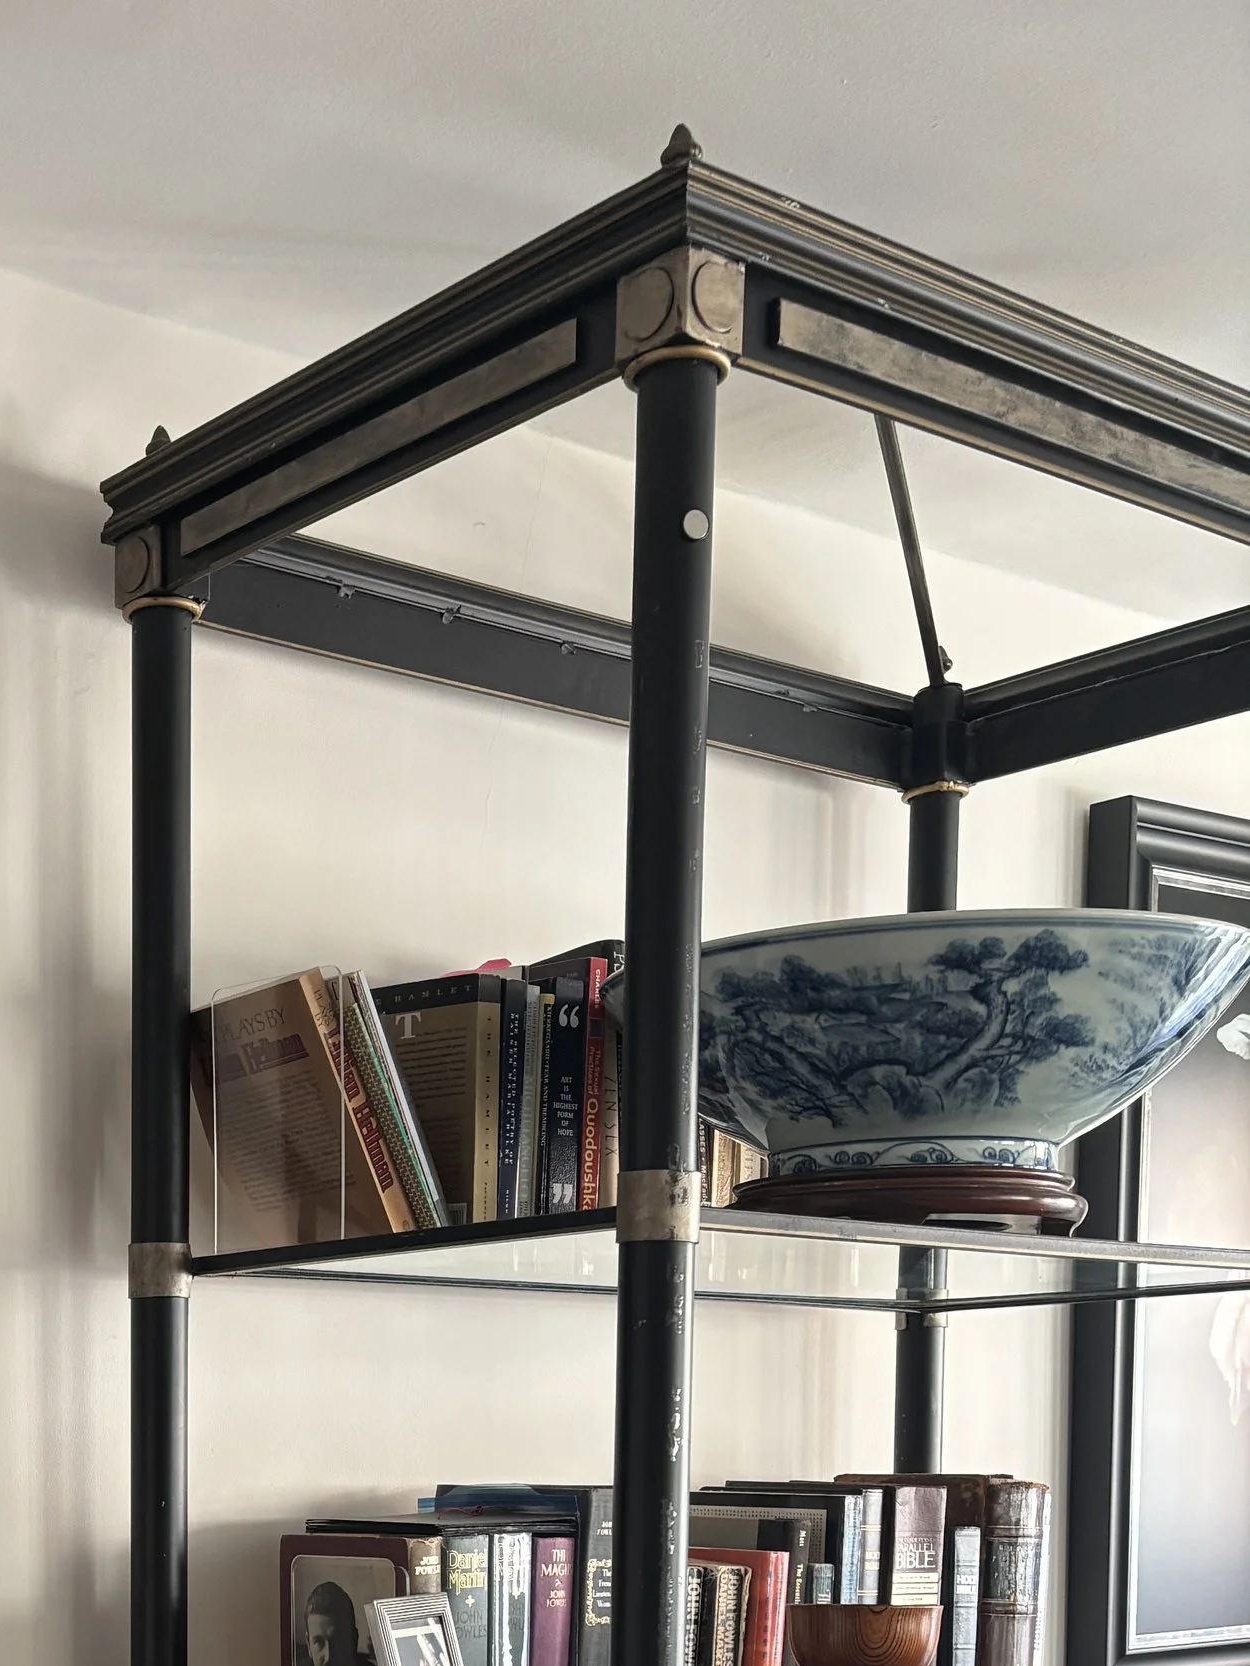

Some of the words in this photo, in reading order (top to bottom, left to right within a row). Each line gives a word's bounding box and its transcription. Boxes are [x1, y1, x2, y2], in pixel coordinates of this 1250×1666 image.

[394, 985, 472, 1003] HAMLET
[265, 1006, 285, 1028] BY
[560, 1076, 573, 1084] ART
[553, 1101, 578, 1110] HIGHEST
[560, 1093, 573, 1101] THE
[557, 1110, 574, 1119] FORM
[561, 1119, 569, 1127] OF
[557, 1128, 574, 1137] HOPE
[604, 1120, 618, 1158] SEX
[352, 1101, 394, 1194] Hellman
[446, 1549, 488, 1571] Daniel
[895, 1552, 936, 1569] BIBLE
[687, 1576, 701, 1621] JOHN
[717, 1574, 728, 1624] DANIEL
[726, 1574, 740, 1614] JOHN
[454, 1609, 484, 1625] JOHN
[456, 1624, 488, 1639] OWLES
